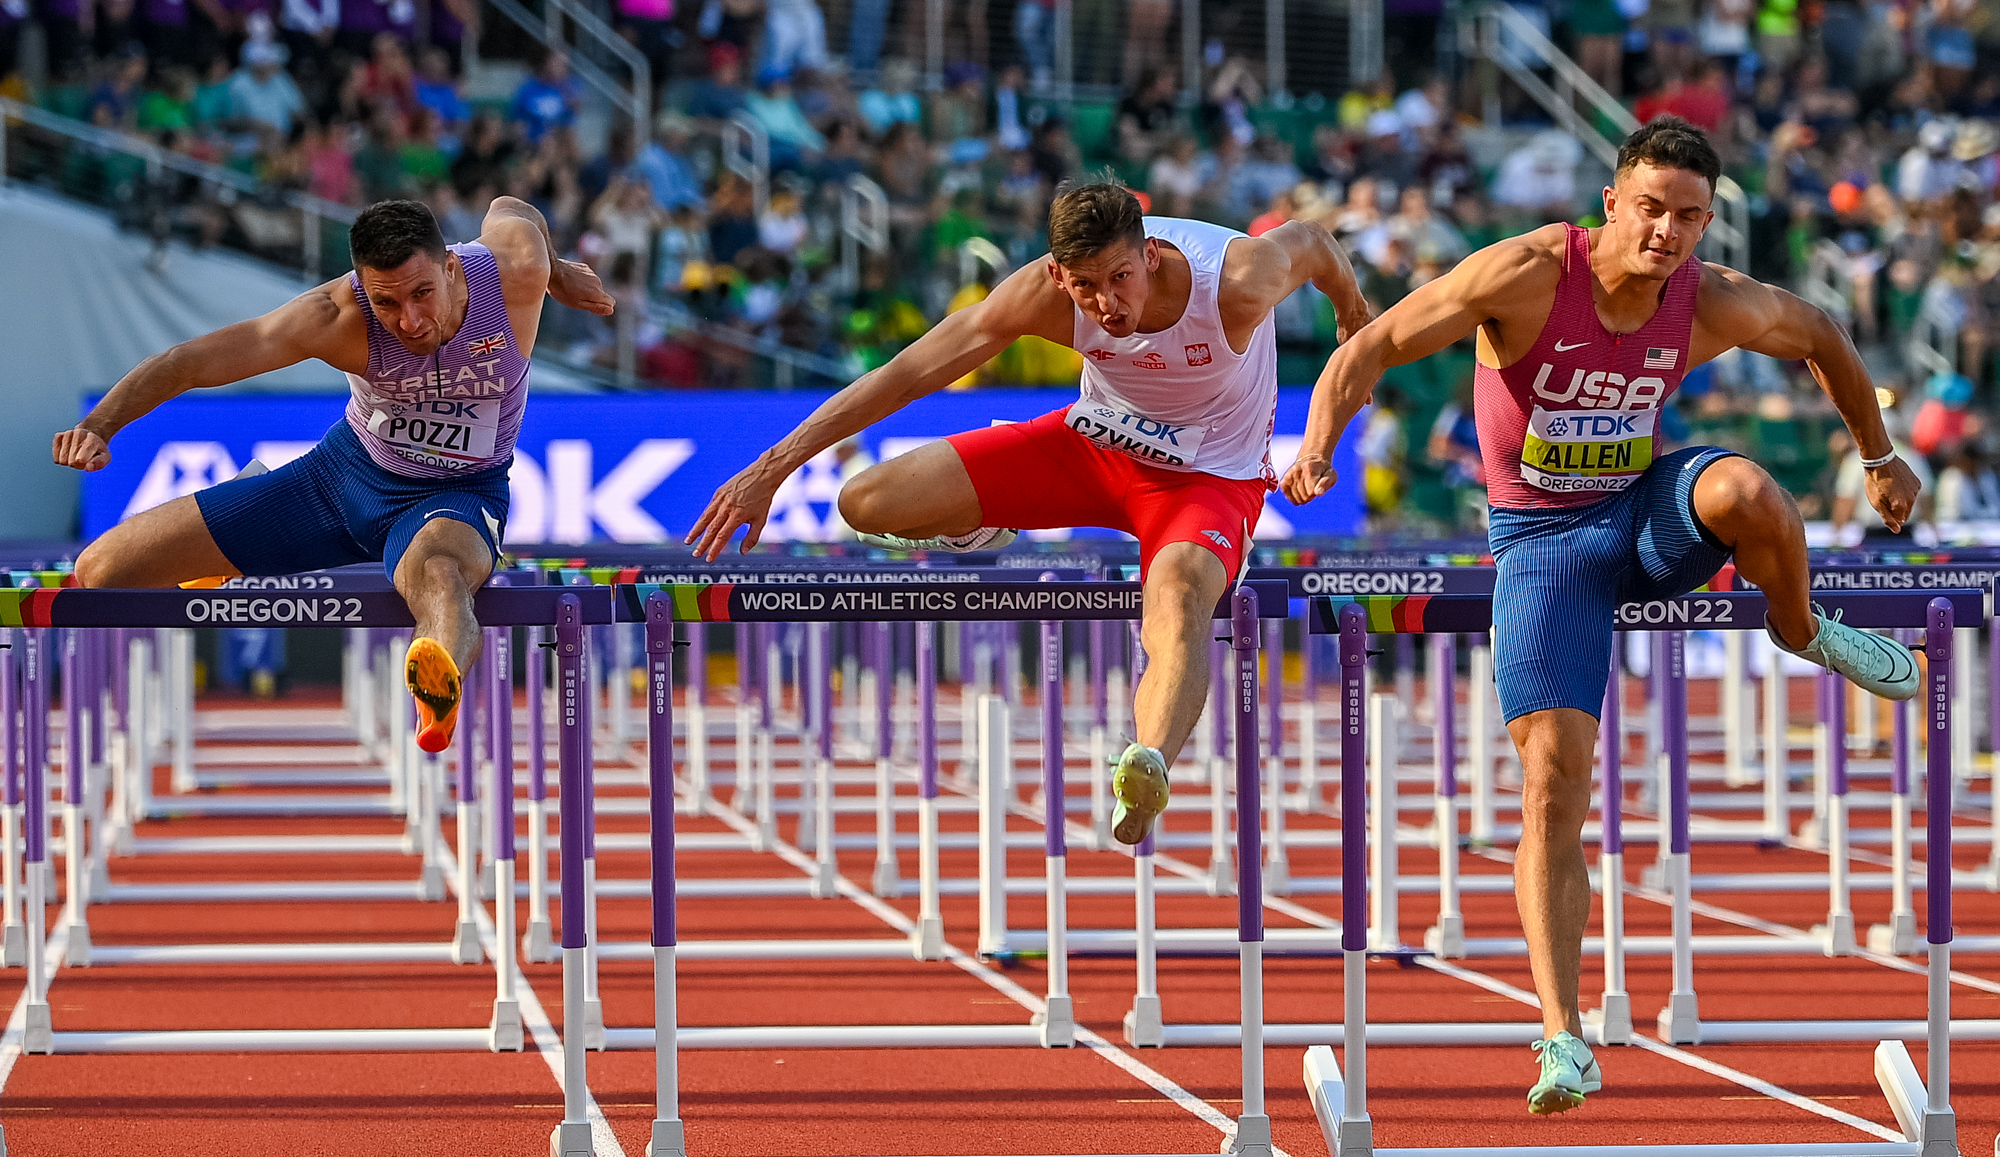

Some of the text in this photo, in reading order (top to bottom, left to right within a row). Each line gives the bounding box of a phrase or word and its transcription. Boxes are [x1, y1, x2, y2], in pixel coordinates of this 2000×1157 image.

[373, 358, 501, 393] GREAT
[1134, 361, 1164, 369] ORLEN
[1532, 363, 1666, 411] USA
[415, 402, 480, 420] TDK
[1569, 415, 1639, 436] TDK
[388, 416, 471, 452] POZZI
[1541, 441, 1632, 469] ALLEN
[1539, 476, 1629, 490] OREGON22
[1812, 571, 2000, 589] ATHLETICS CHAMPI
[186, 598, 363, 622] OREGON22
[741, 591, 1142, 610] WORLD ATHLETICS CHAMPIONSHIP
[565, 679, 575, 726] MONDO
[655, 673, 665, 714] MONDO
[1242, 672, 1252, 713] MONDO
[1936, 684, 1946, 730] MONDO
[1349, 688, 1359, 735] MONDO
